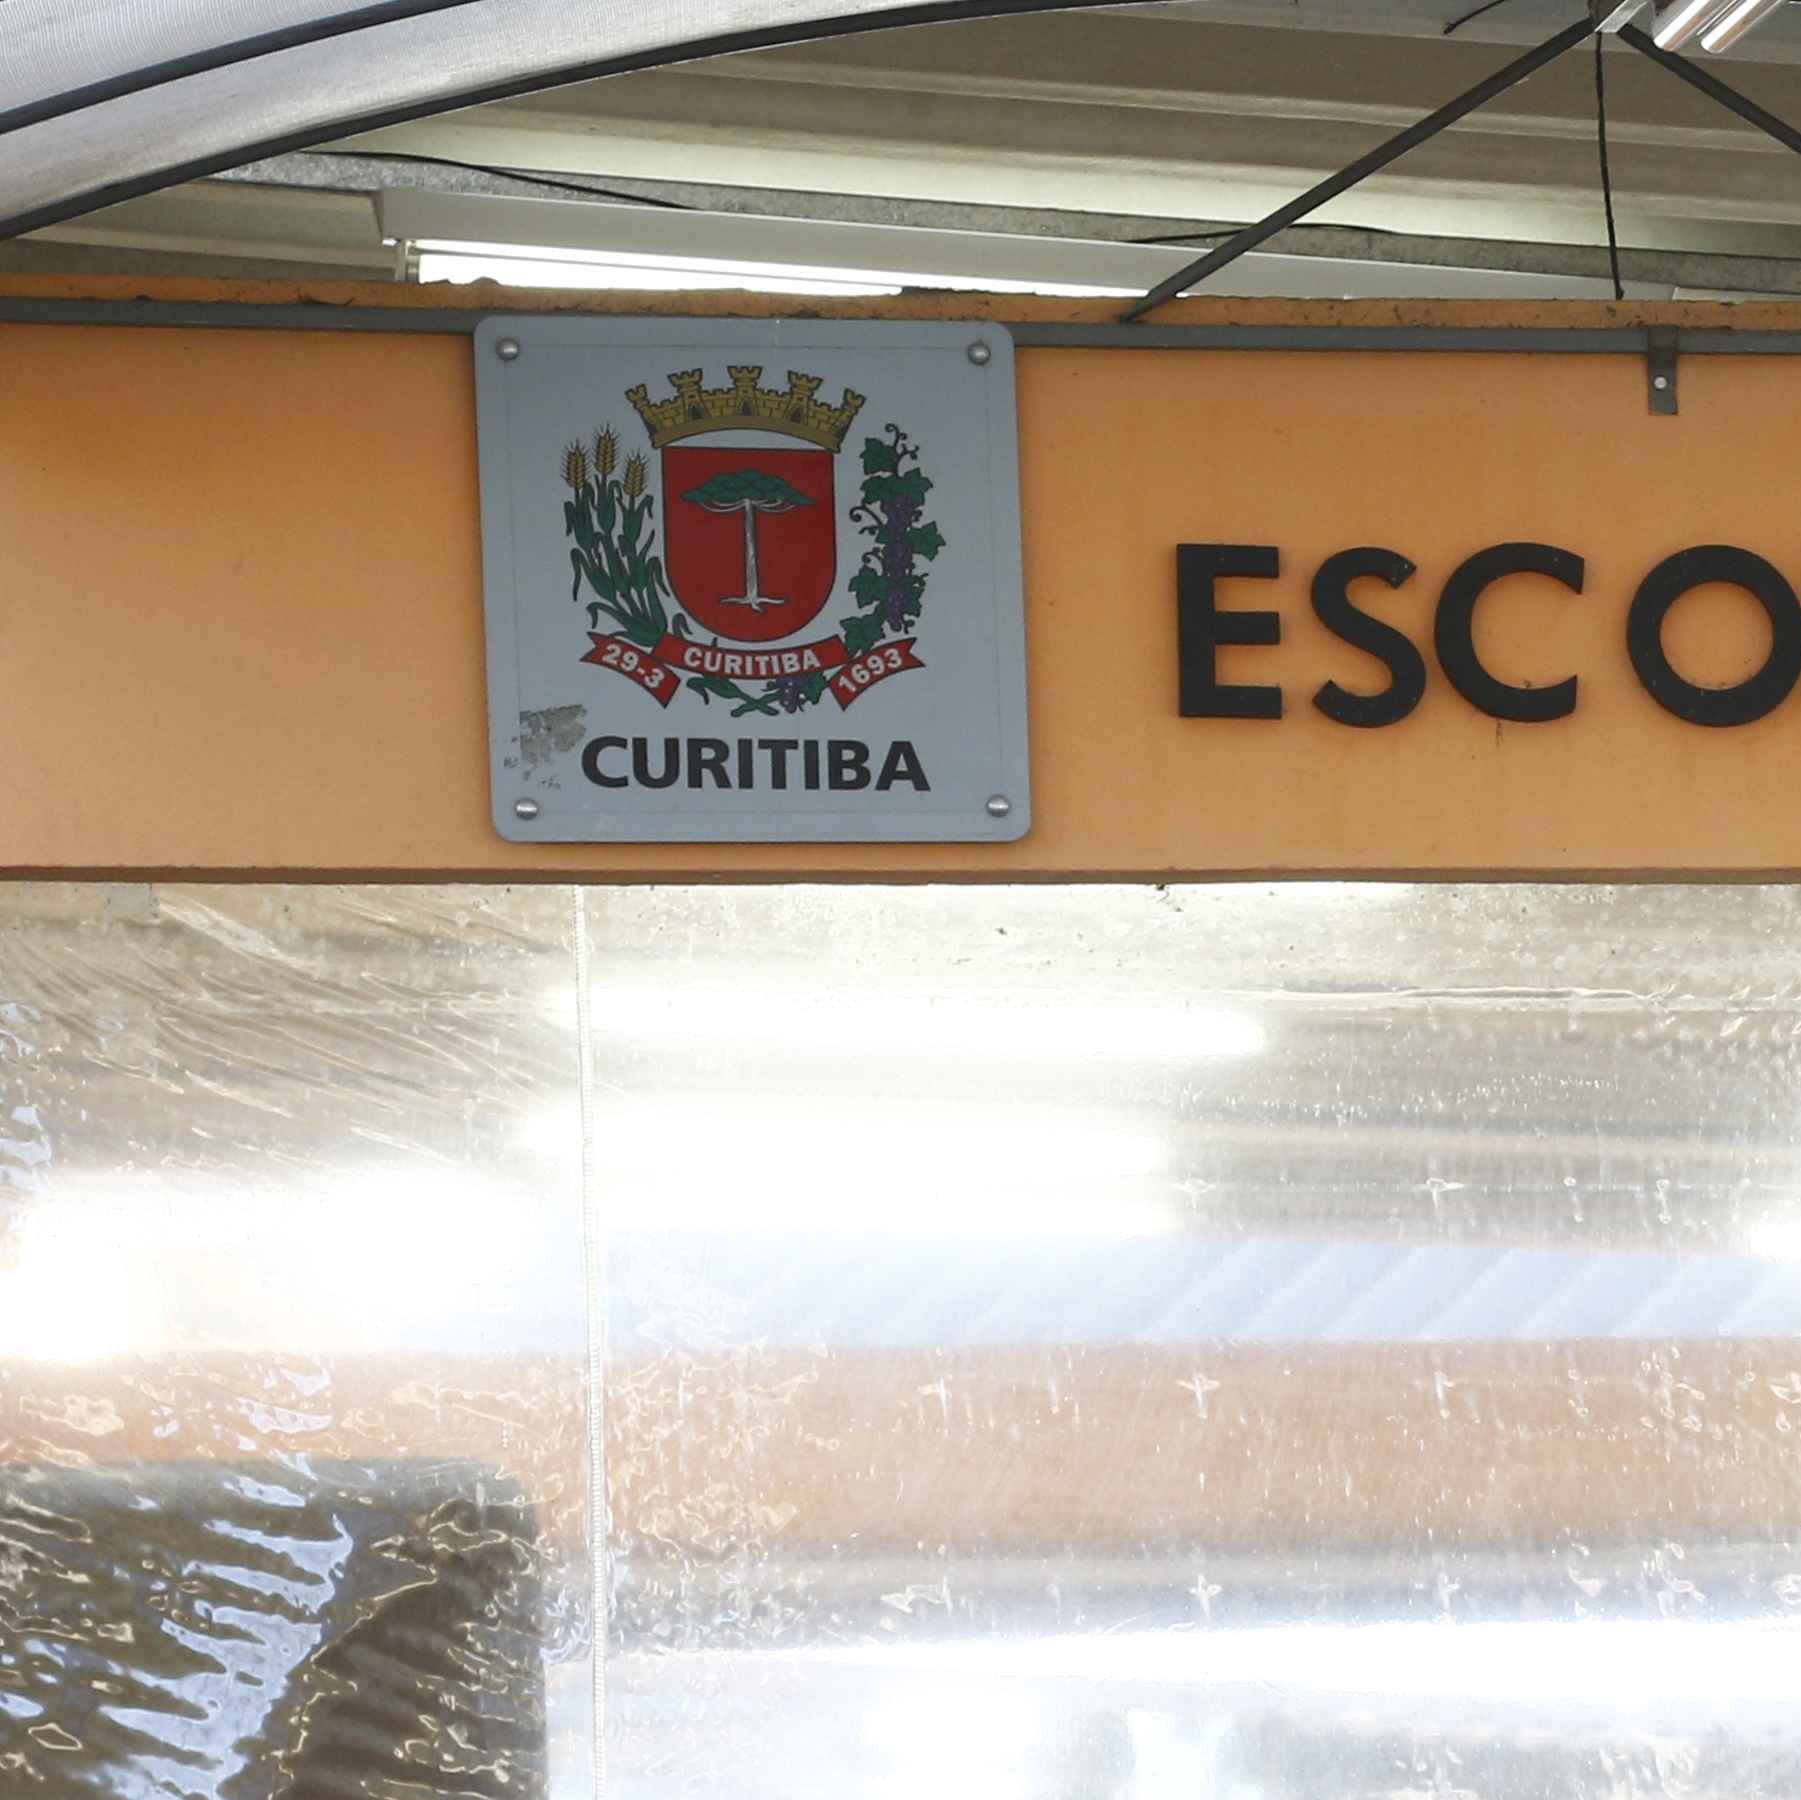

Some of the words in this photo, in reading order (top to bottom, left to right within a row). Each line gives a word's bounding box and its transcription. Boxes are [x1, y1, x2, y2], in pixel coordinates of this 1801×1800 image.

[601, 643, 667, 690] 29-3
[683, 646, 821, 676] CURITIBA
[837, 647, 904, 693] 1693
[580, 735, 932, 792] CURITIBA
